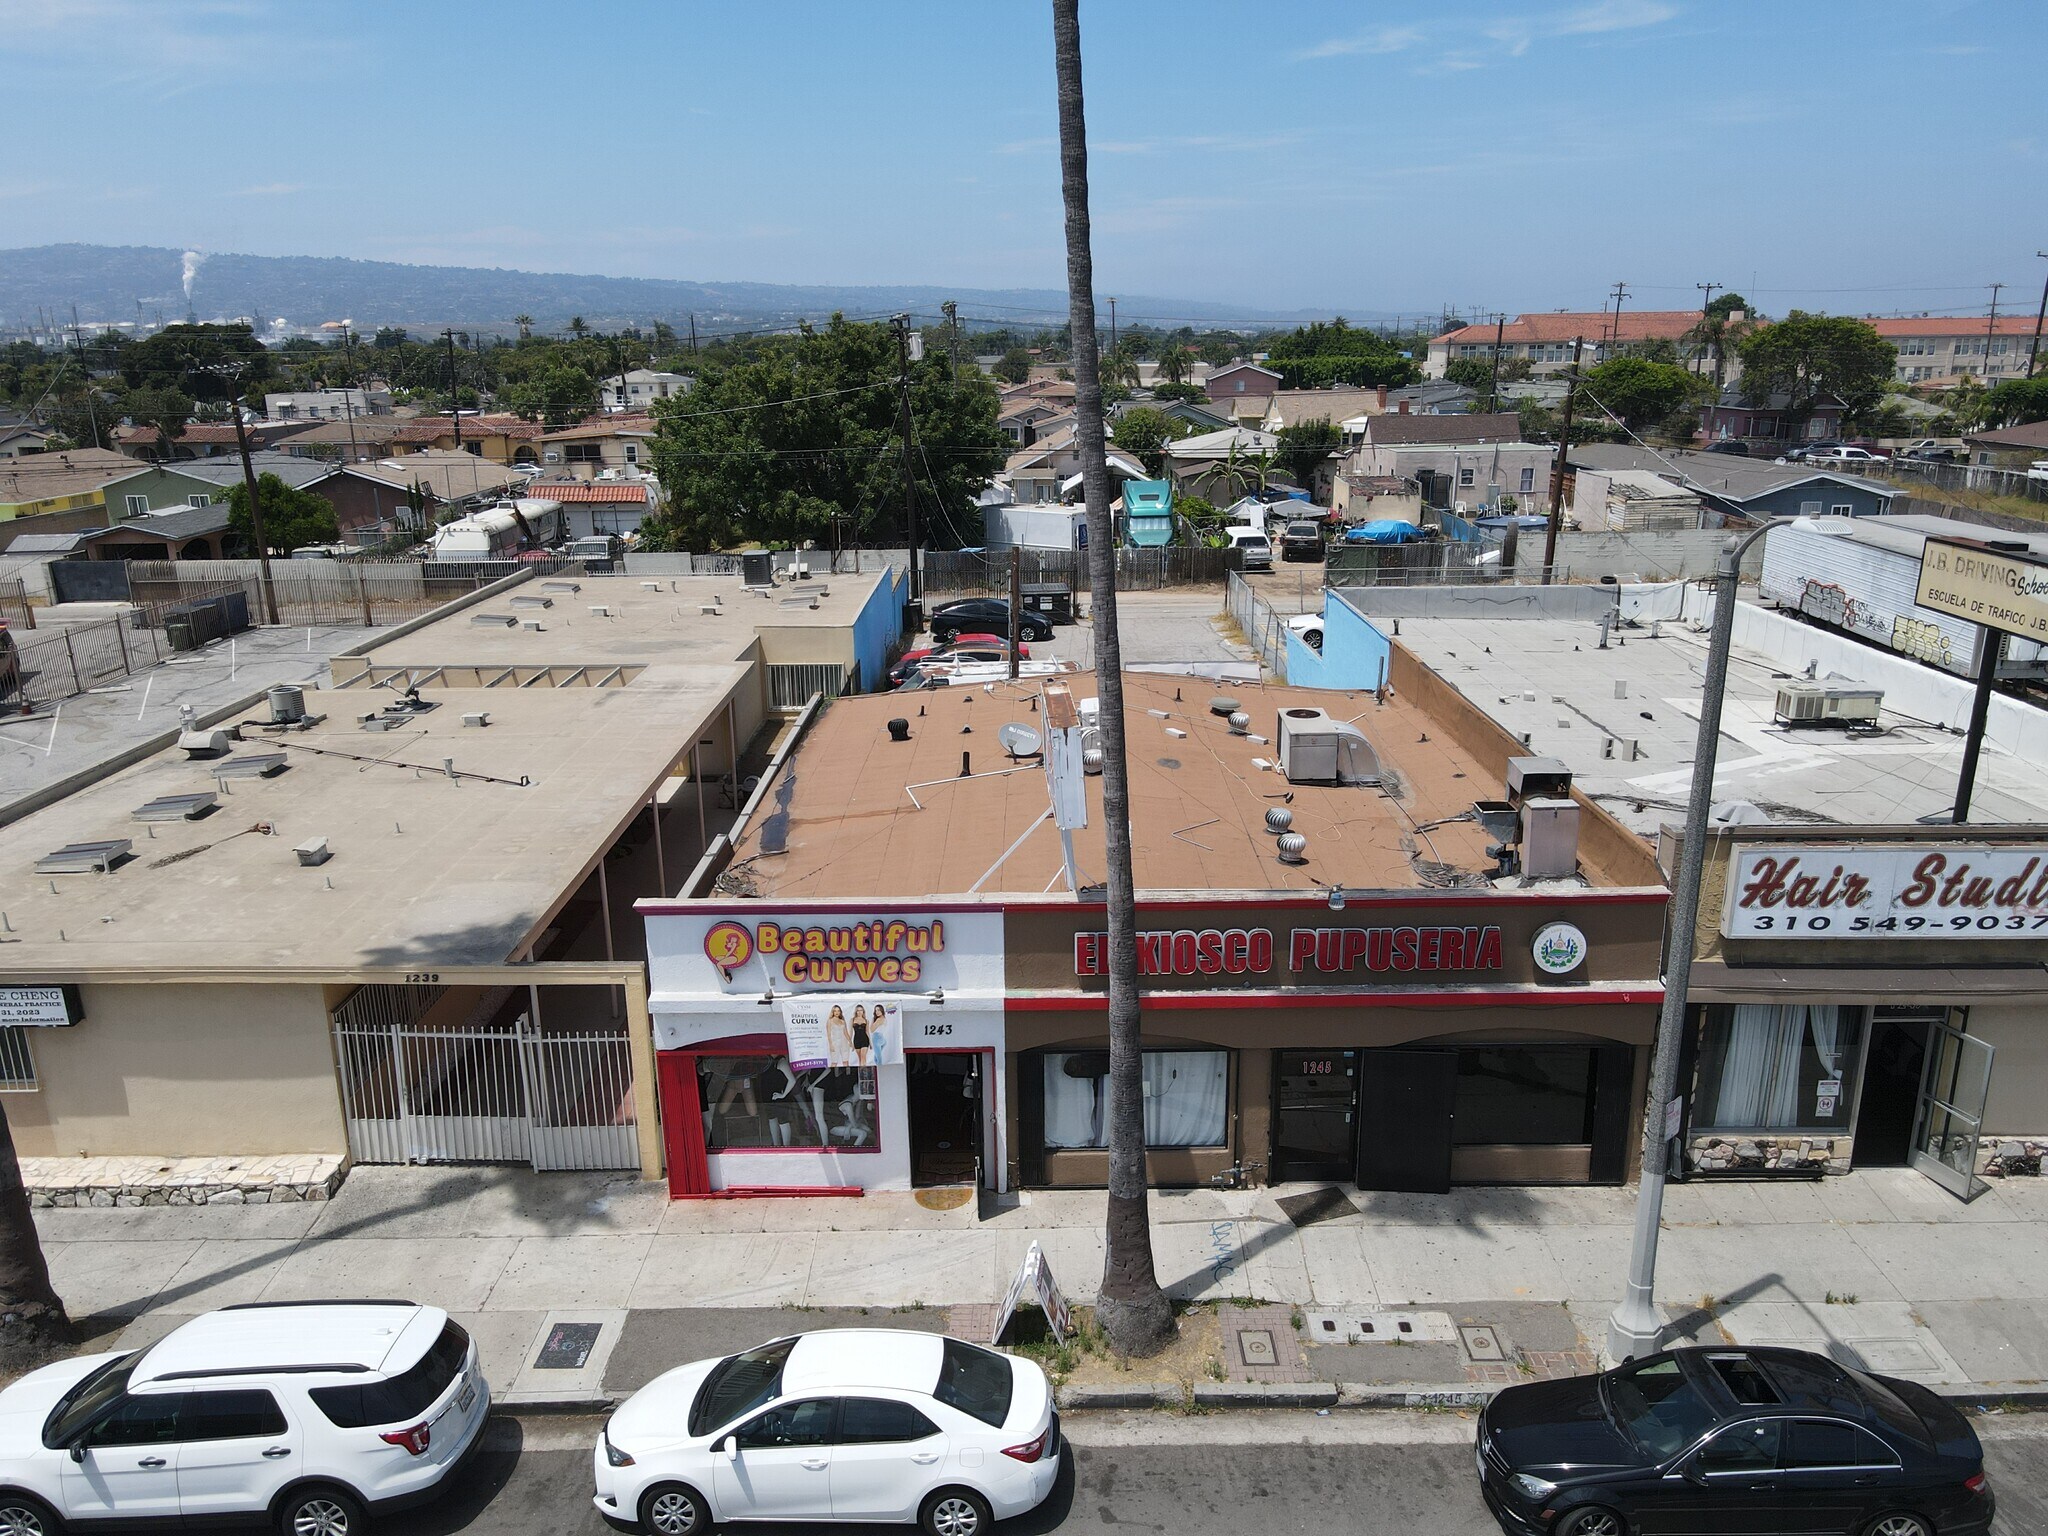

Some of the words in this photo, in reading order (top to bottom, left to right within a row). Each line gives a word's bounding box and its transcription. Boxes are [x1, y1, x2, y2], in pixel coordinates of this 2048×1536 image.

[1926, 550, 1949, 572] J.B.
[1954, 556, 2017, 588] DRIVING
[1928, 588, 1967, 609] ESCUELA
[1970, 600, 1985, 614] DE
[1988, 605, 2026, 626] TRAFICO
[2030, 617, 2048, 632] J.B.
[1738, 856, 1870, 908] Hair
[756, 919, 945, 954] Beautiful
[1753, 915, 1832, 931] 310
[1848, 915, 2048, 931] 549-9037
[1135, 927, 1274, 976] KIOSCO
[1290, 924, 1504, 974] PUPUSERIA
[404, 973, 440, 983] 1239
[782, 952, 922, 984] Curves
[10, 991, 59, 1000] CHENG
[923, 1023, 953, 1037] 1243
[1303, 1060, 1332, 1074] 1245
